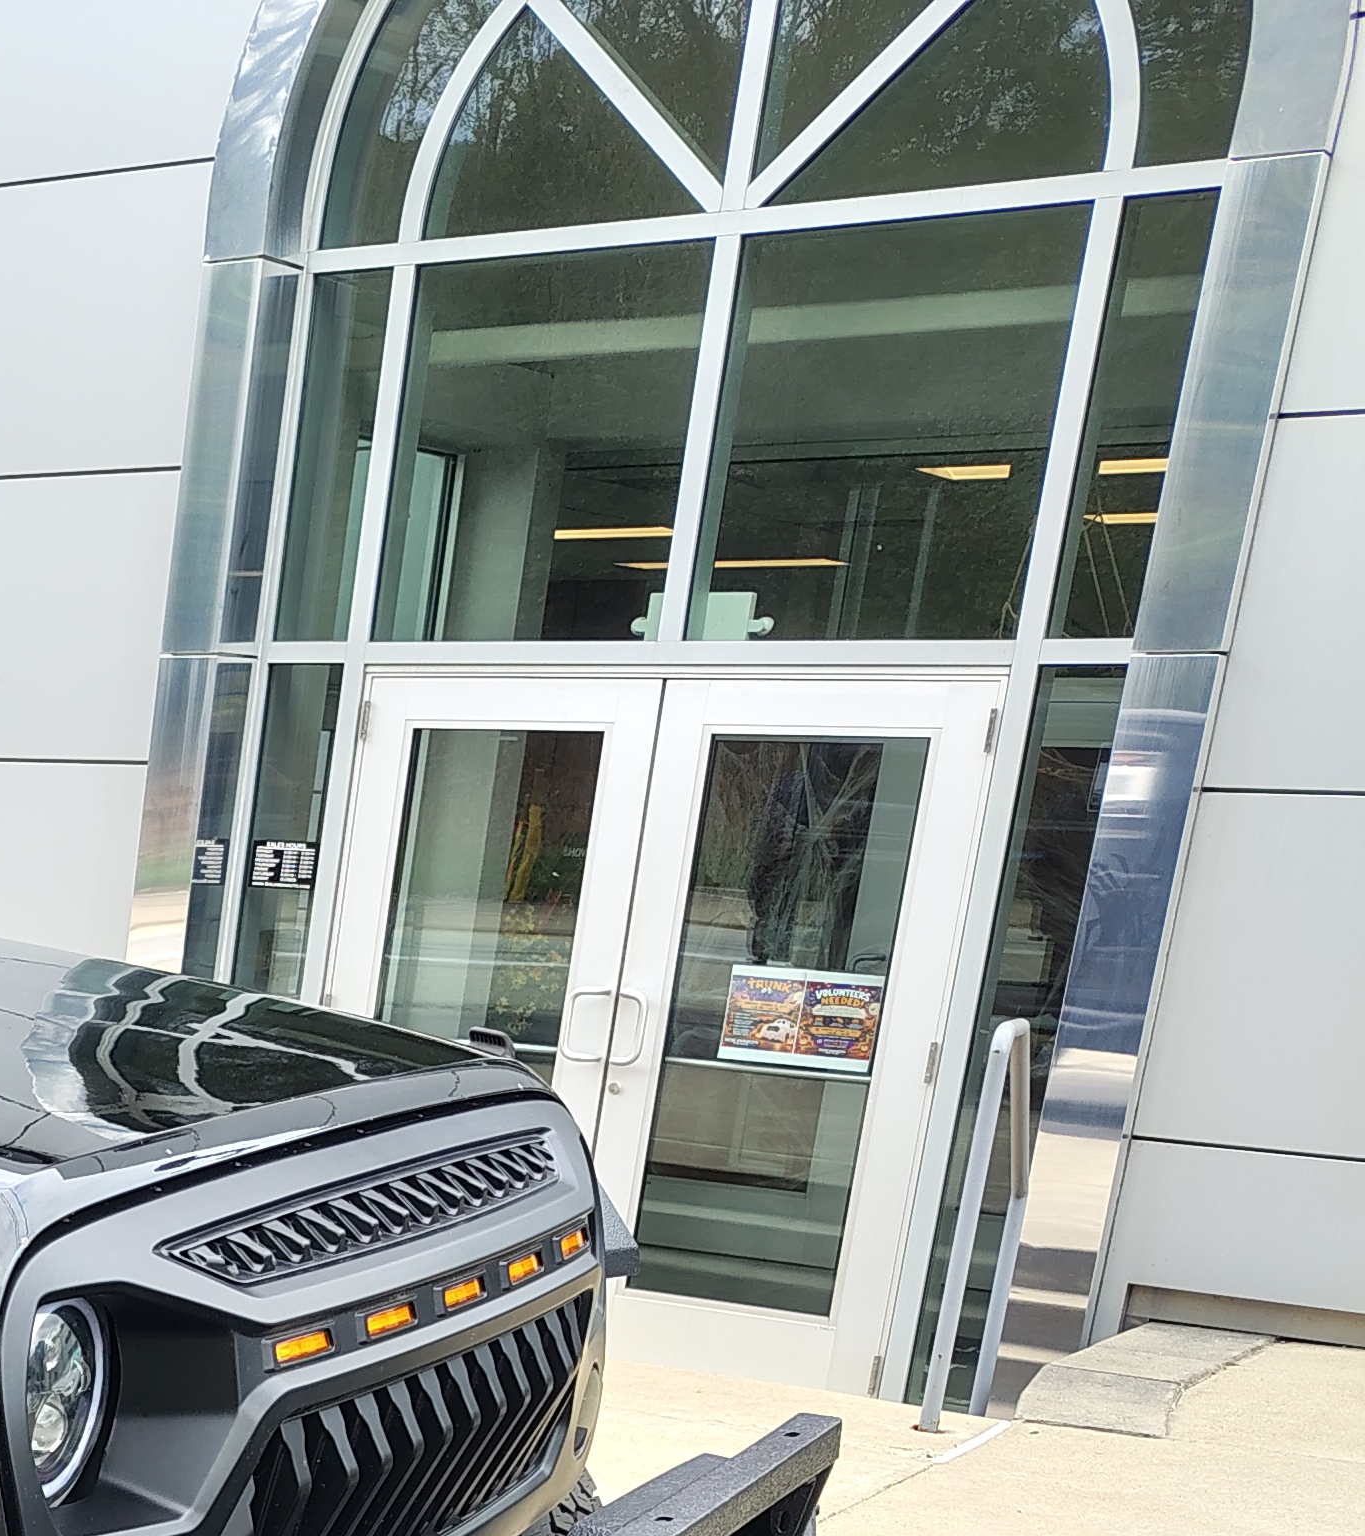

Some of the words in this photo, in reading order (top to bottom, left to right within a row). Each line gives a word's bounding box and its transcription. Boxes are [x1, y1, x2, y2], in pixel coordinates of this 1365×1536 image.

[747, 976, 792, 993] TRUNK
[815, 988, 872, 1002] VOLUNTEERS
[821, 996, 865, 1008] NEEDED!
